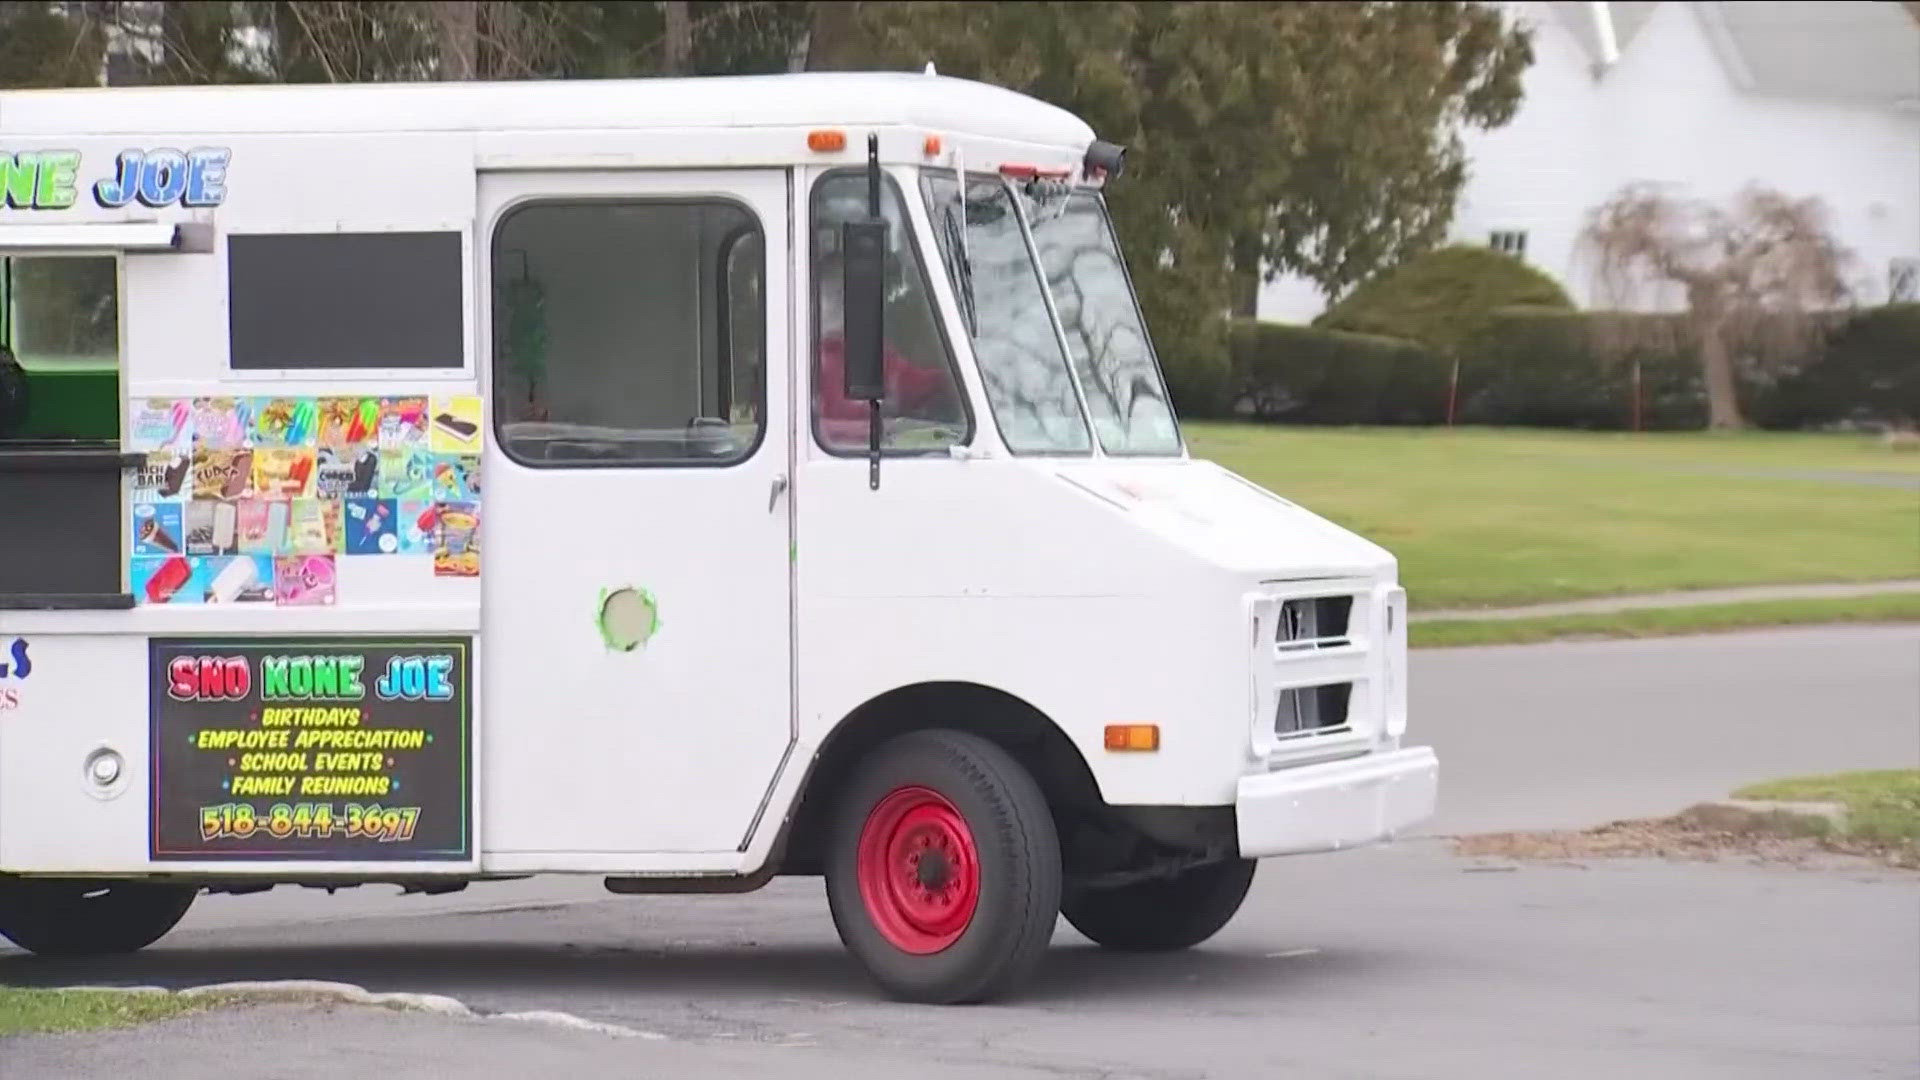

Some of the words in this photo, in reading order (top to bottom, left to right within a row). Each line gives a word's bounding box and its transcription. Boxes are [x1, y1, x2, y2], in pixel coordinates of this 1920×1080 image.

[92, 147, 232, 208] JOE
[168, 655, 250, 701] SNO
[261, 655, 366, 701] KONE
[376, 655, 454, 701] JOE
[261, 707, 360, 727] BIRTHDAYS
[197, 729, 290, 749] EMPLOYEE
[294, 729, 424, 749] APPRECIATION
[240, 753, 308, 772] SCHOOL
[314, 753, 384, 771] EVENTS
[231, 776, 295, 795] FAMILY
[301, 776, 390, 795] REUNIONS
[200, 803, 421, 843] 518-844-3697
